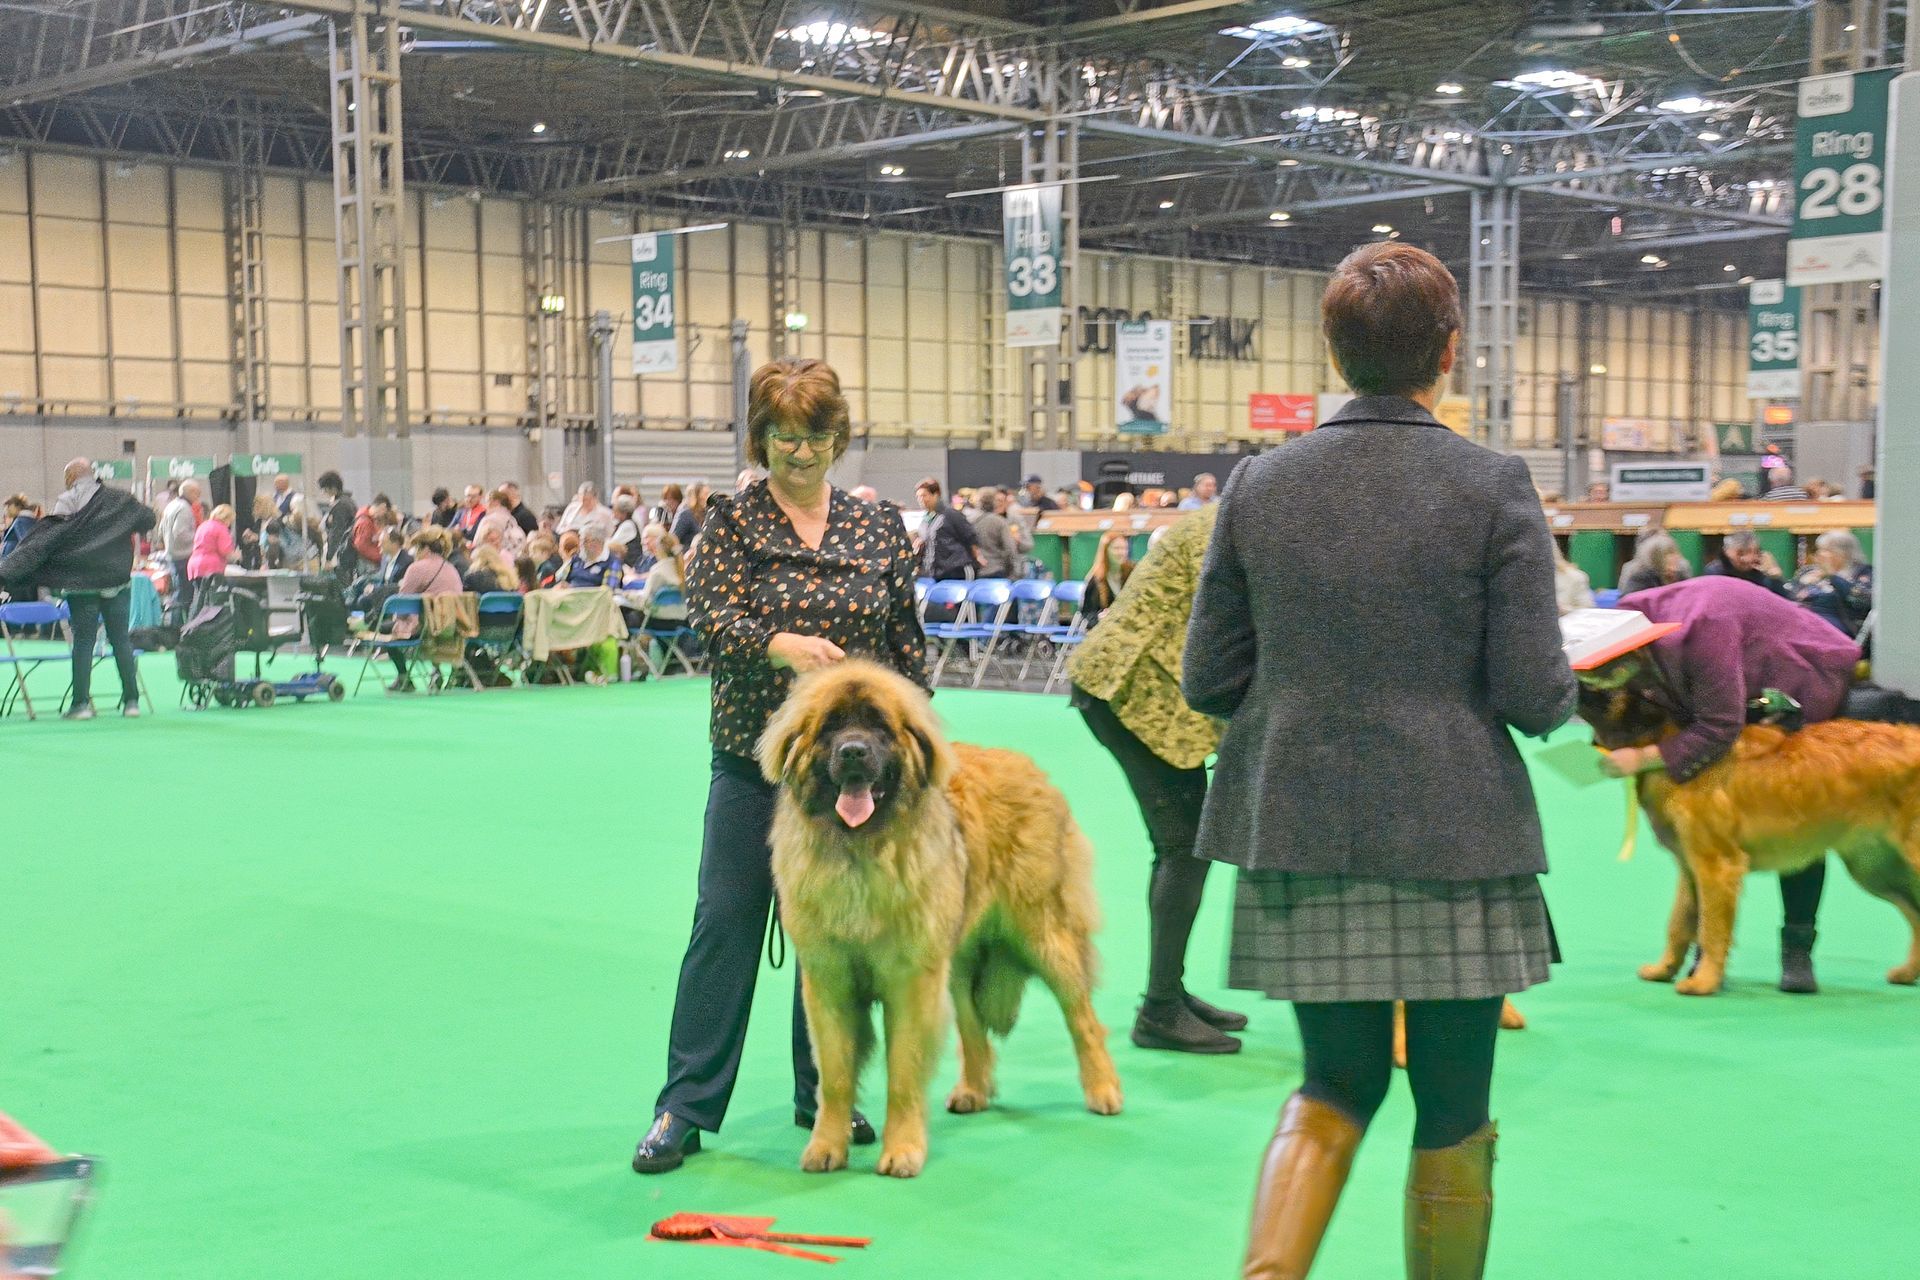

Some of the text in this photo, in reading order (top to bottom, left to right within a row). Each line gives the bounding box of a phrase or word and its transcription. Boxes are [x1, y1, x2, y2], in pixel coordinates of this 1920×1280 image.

[1812, 130, 1874, 159] Ring
[1800, 163, 1882, 219] 28
[639, 271, 668, 292] Ring
[1009, 254, 1057, 297] 33
[636, 294, 673, 331] 34
[1751, 331, 1799, 362] 35
